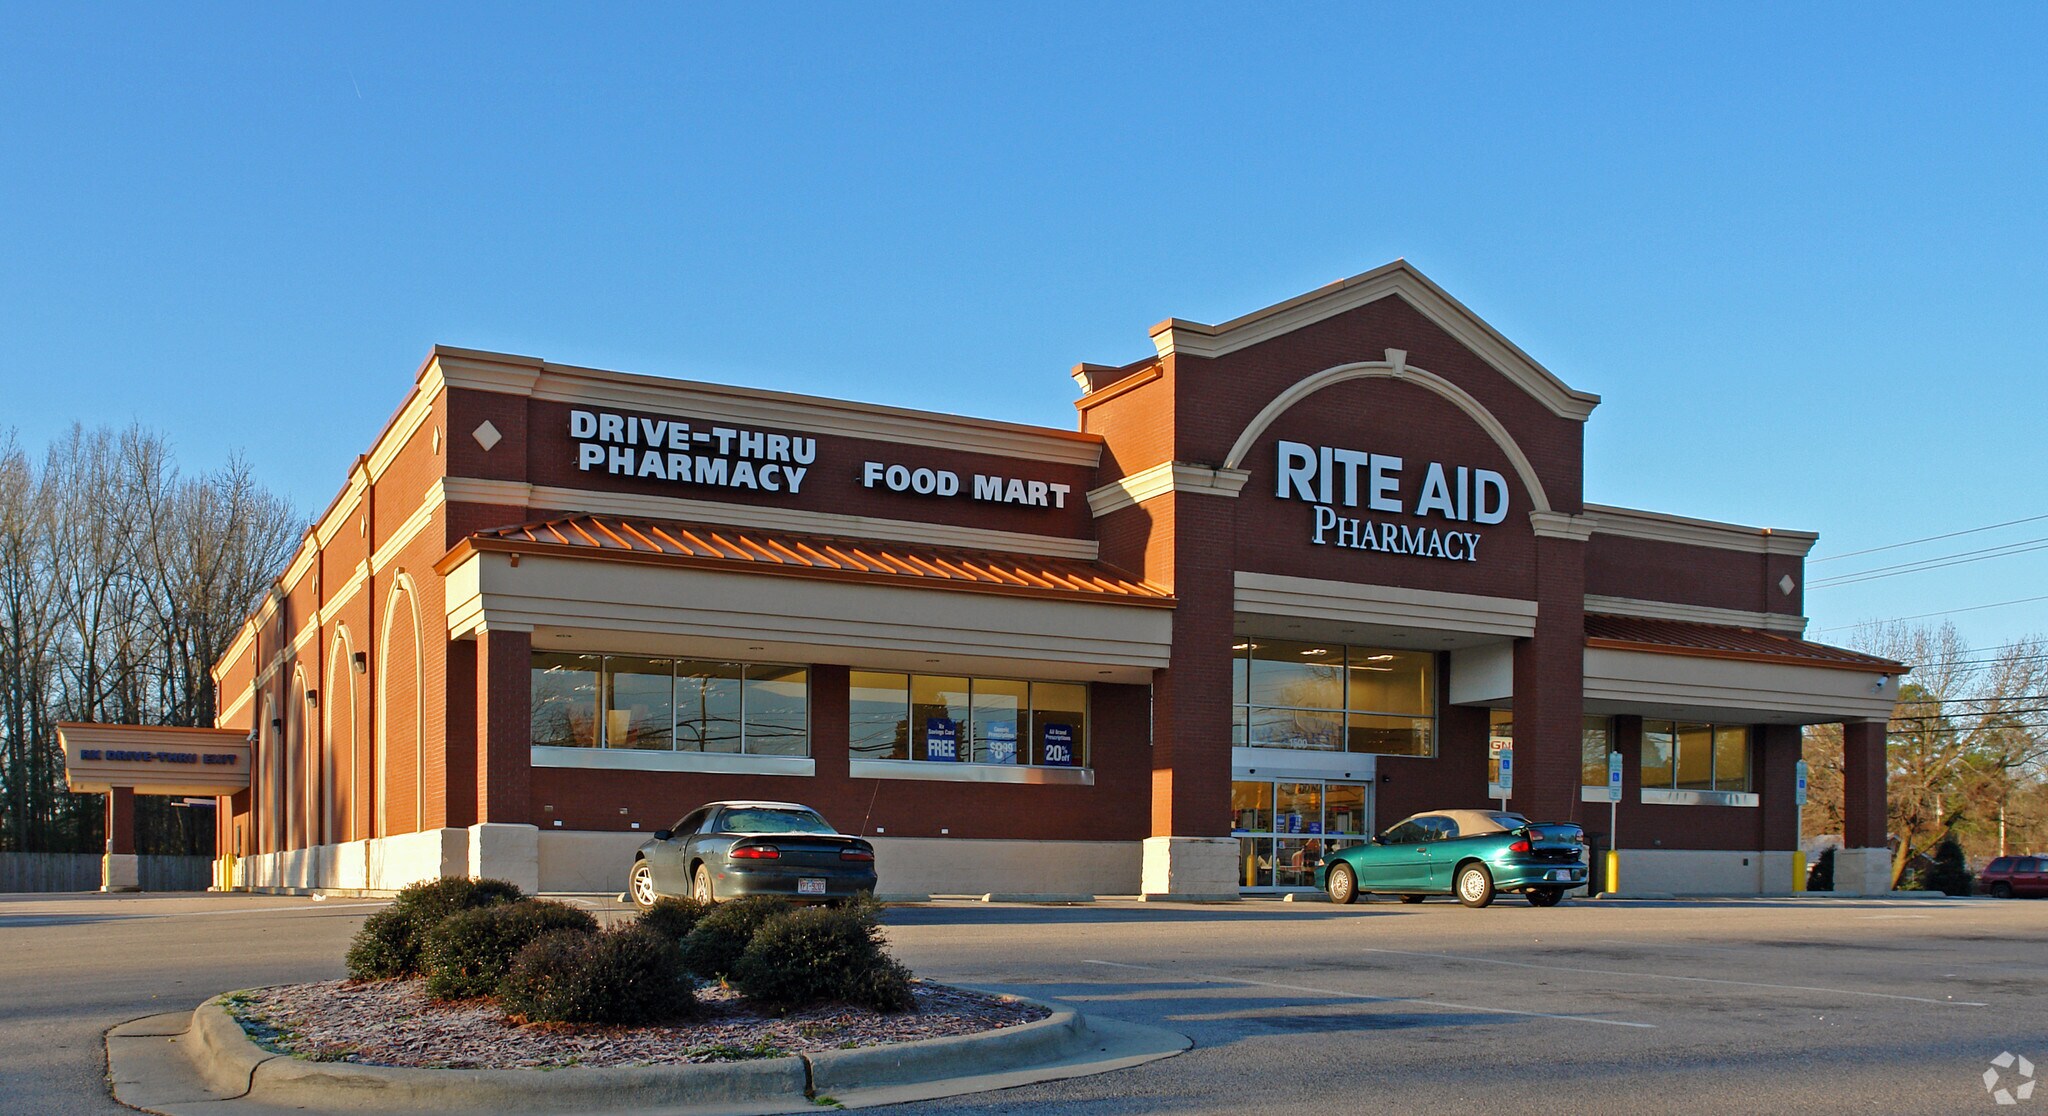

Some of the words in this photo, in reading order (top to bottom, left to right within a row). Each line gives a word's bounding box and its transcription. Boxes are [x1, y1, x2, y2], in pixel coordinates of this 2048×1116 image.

[570, 410, 817, 465] DRIVE-THRU
[579, 442, 808, 494] PHARMACY
[864, 461, 960, 497] FOOD
[974, 474, 1071, 509] MART
[1277, 440, 1403, 513] RITE
[1416, 462, 1510, 525] AID
[1312, 505, 1481, 562] PHARMACY
[105, 750, 198, 764] DRIVE-THRU
[928, 739, 956, 758] FREE
